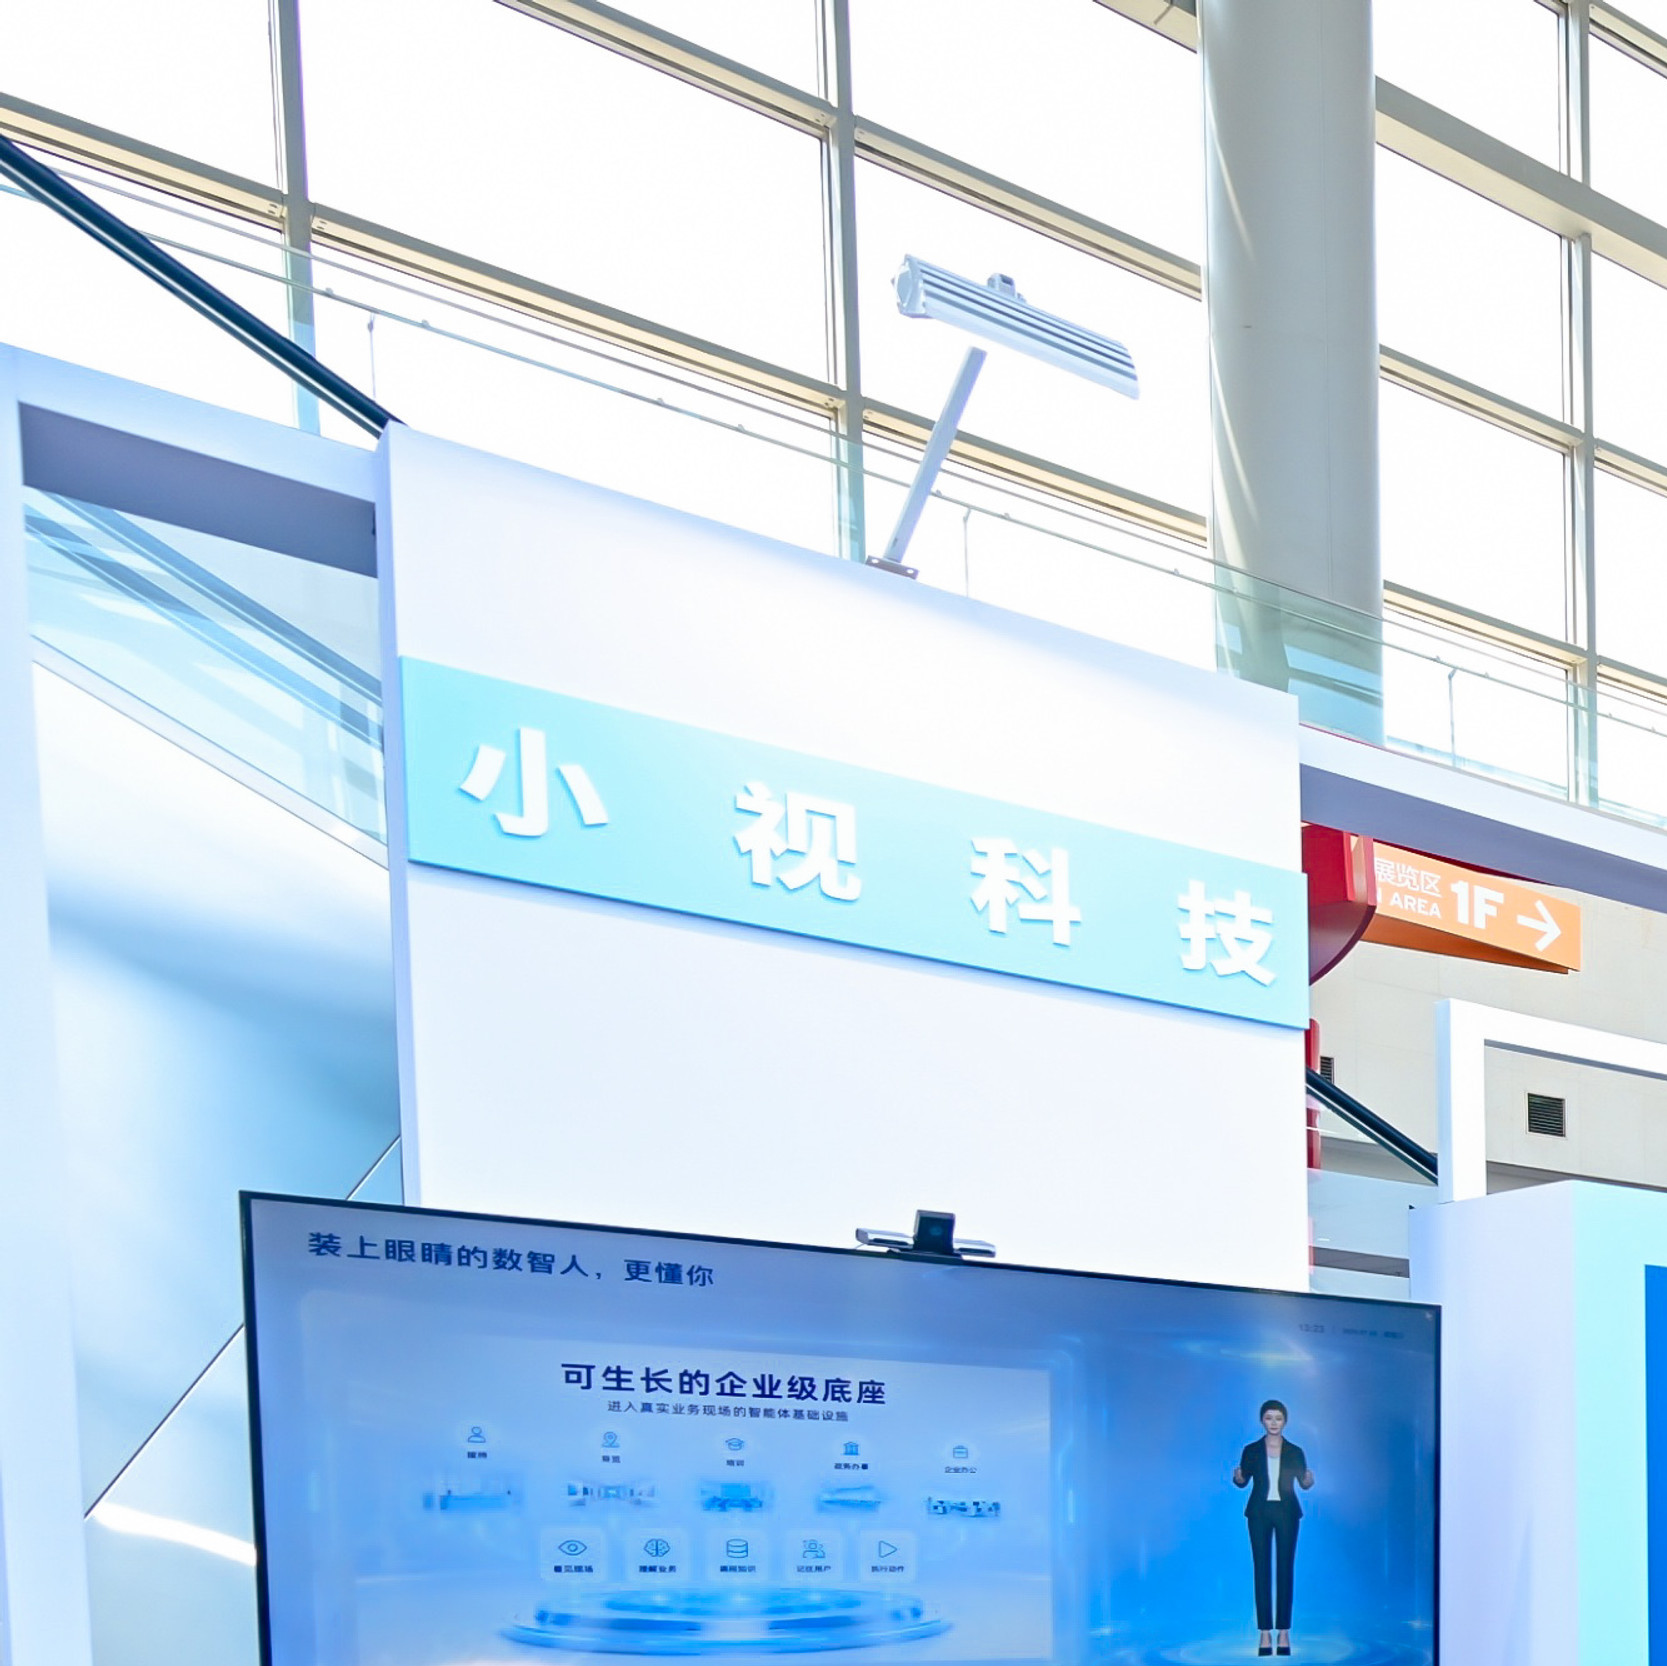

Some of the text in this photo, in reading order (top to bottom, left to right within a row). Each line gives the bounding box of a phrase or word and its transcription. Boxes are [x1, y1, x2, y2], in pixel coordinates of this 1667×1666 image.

[460, 726, 1280, 988] 小视科技
[1375, 857, 1442, 898] 展览区
[1390, 879, 1505, 930] AREA 1F
[308, 1231, 715, 1288] 装上眼睛的数智人，更懂你
[560, 1362, 887, 1405] 可生长的企业级底座
[607, 1400, 850, 1423] 进入真实业务现场的智能体基础设施
